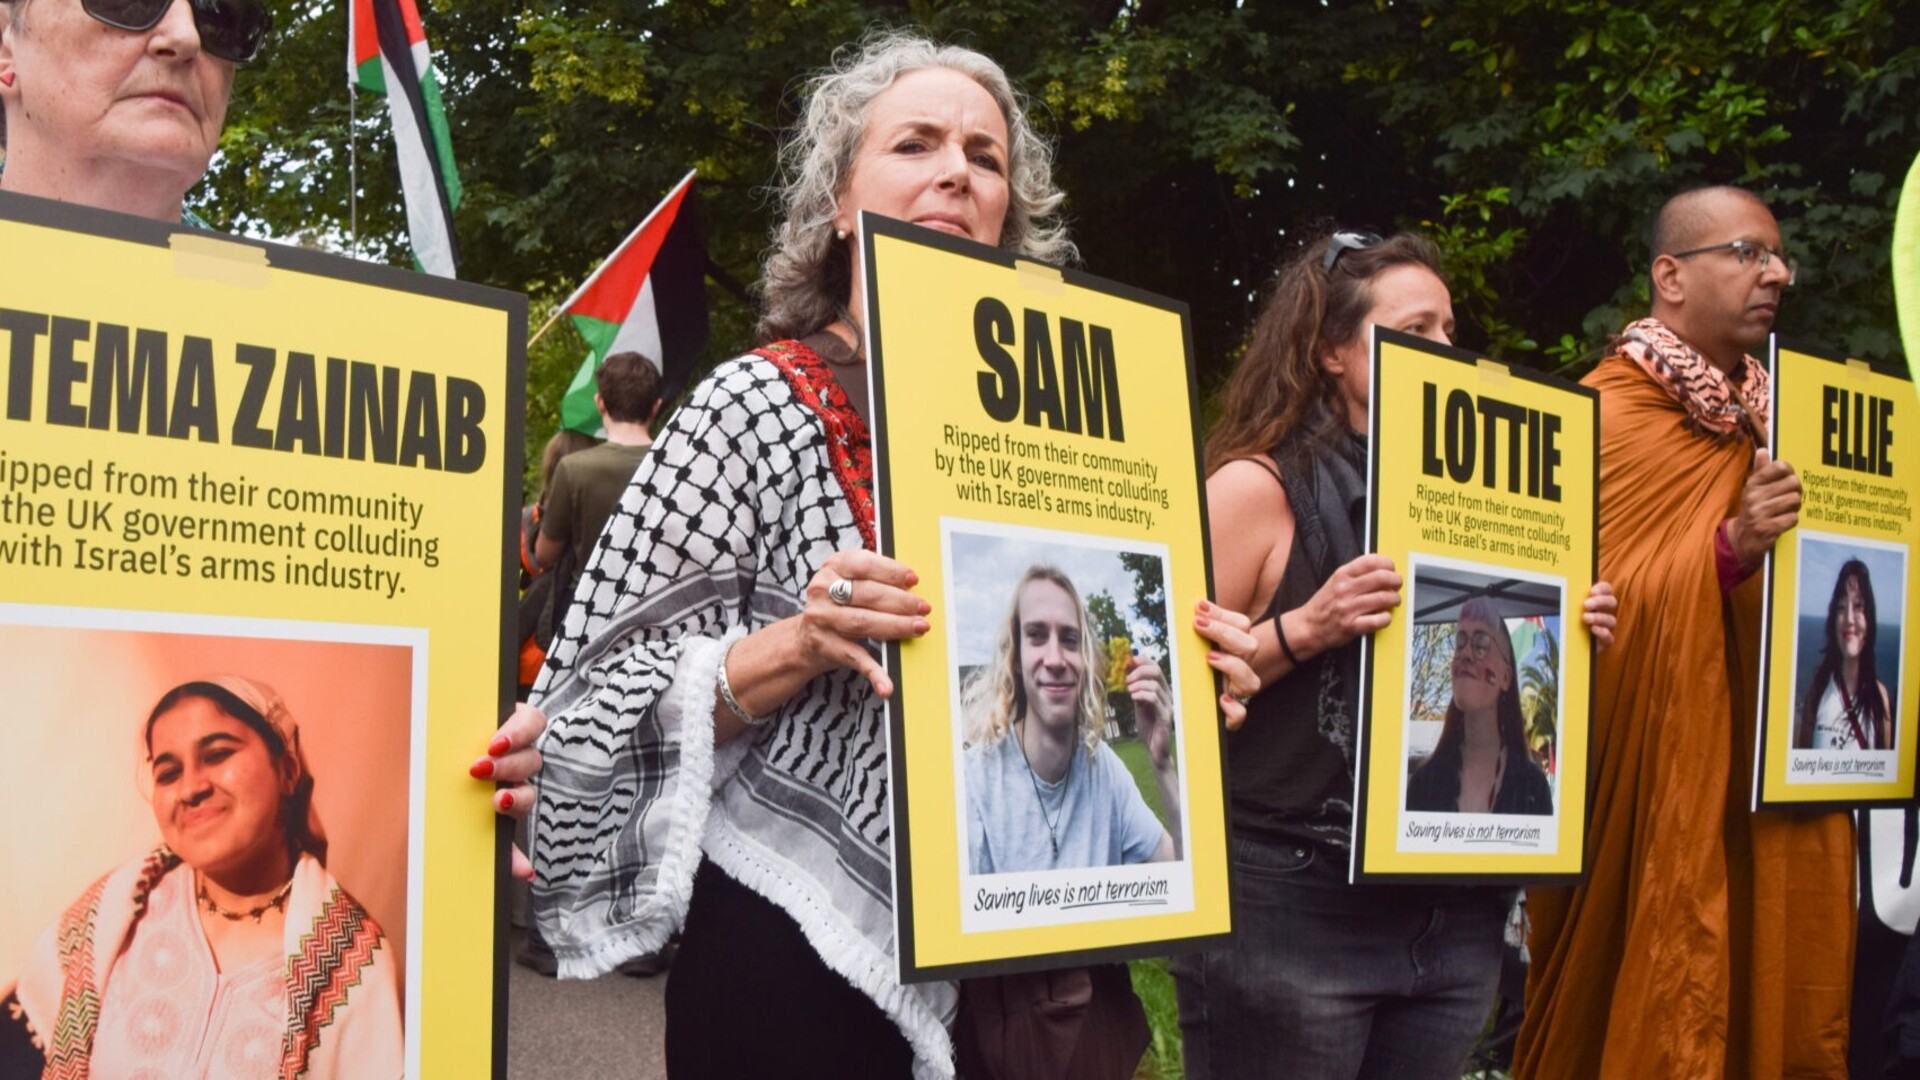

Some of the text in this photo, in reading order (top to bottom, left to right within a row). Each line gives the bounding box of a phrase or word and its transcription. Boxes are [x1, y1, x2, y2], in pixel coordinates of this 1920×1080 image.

[973, 296, 1125, 443] SAM
[232, 342, 486, 474] ZAINAB
[944, 424, 1157, 483] Ripped from their community
[1422, 381, 1562, 503] LOTTIE
[104, 462, 177, 499] from
[188, 472, 259, 508] their
[267, 487, 423, 530] community
[935, 449, 1169, 509] by the UK government colluding
[956, 481, 1155, 530] with Israel’s arms industry.
[1417, 484, 1565, 529] Ripped from their community
[1, 494, 440, 567] the UK government colluding
[1409, 502, 1570, 551] by the UK government colluding
[1422, 526, 1445, 543] with
[1490, 539, 1514, 556] arms
[1517, 543, 1559, 566] industry.
[73, 539, 191, 578] Israel’s
[200, 551, 275, 584] arms
[285, 556, 406, 599] industry.
[1406, 821, 1540, 842] Saving lives is not terrorism.
[974, 876, 1169, 914] Saving lives is not terrorism.
